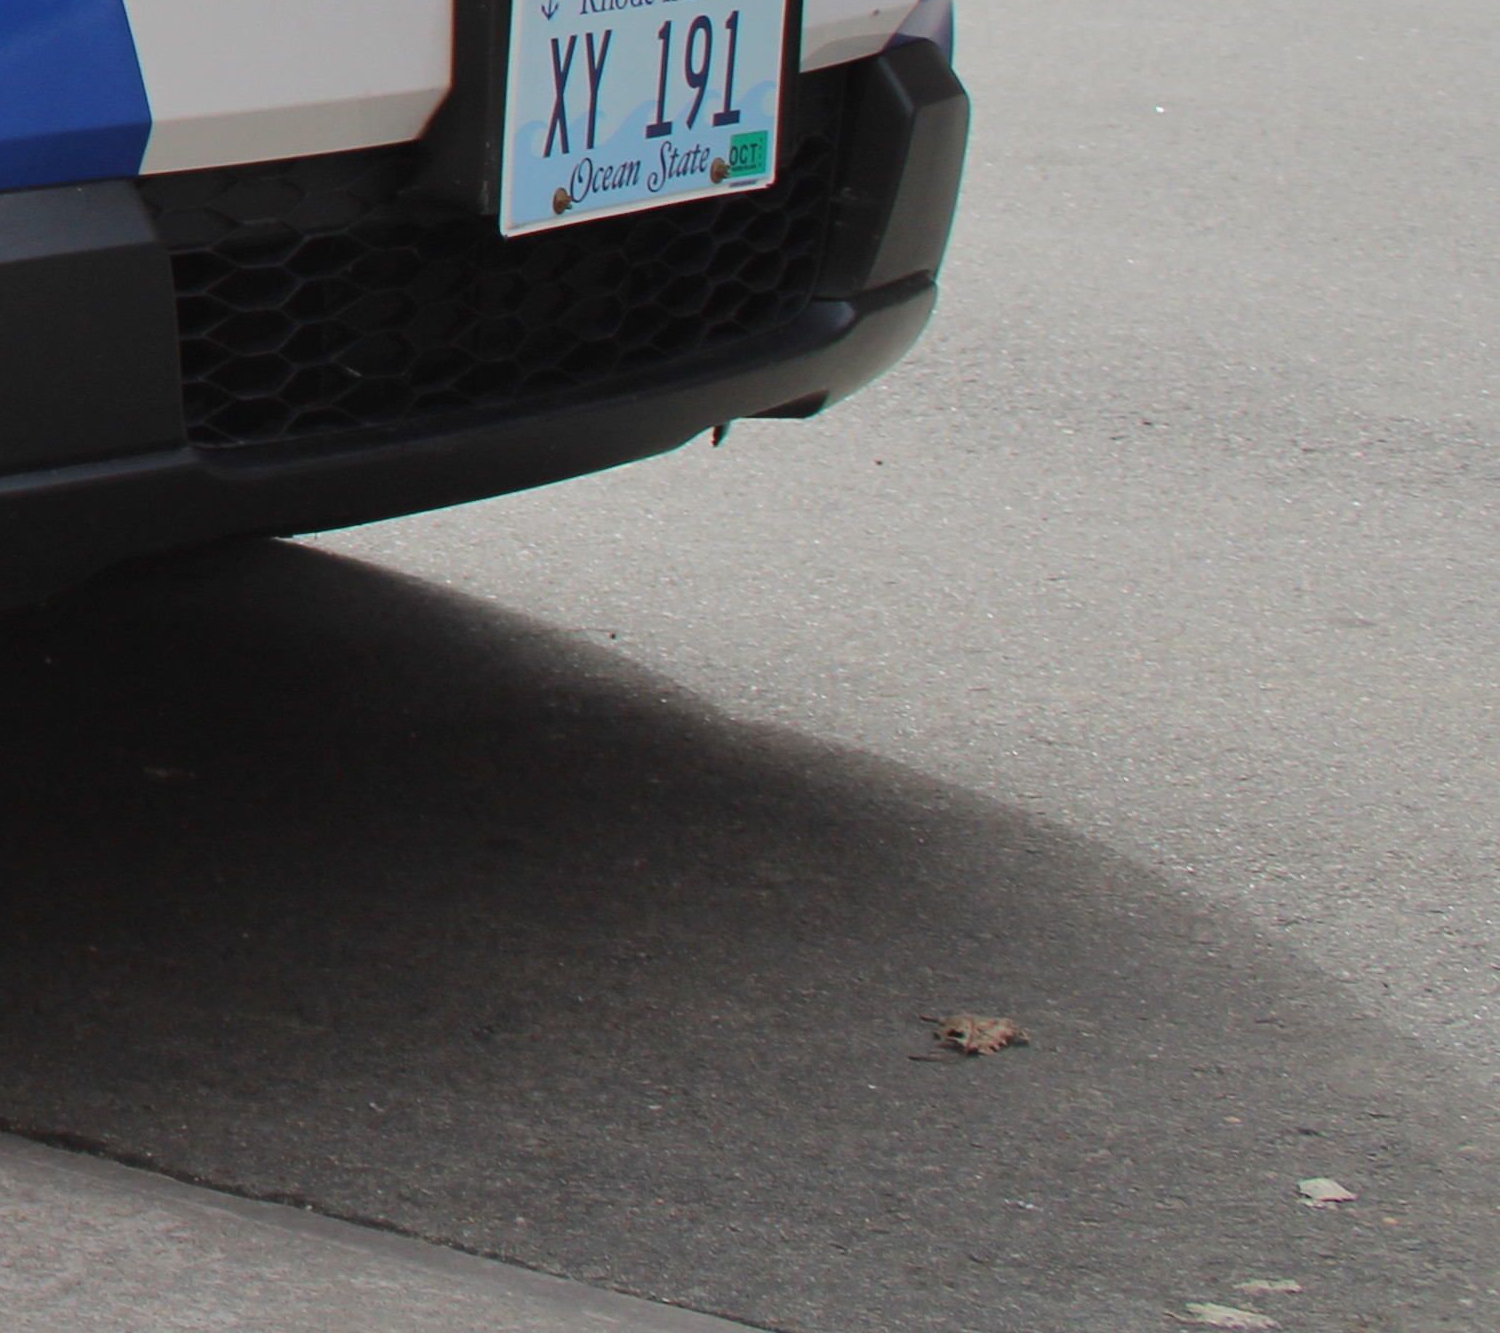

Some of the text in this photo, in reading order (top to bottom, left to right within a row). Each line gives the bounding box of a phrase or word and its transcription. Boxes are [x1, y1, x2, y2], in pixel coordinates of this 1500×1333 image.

[543, 10, 740, 158] XY 191
[569, 157, 641, 203] Ocean
[647, 140, 710, 192] State
[729, 143, 758, 166] OCT
